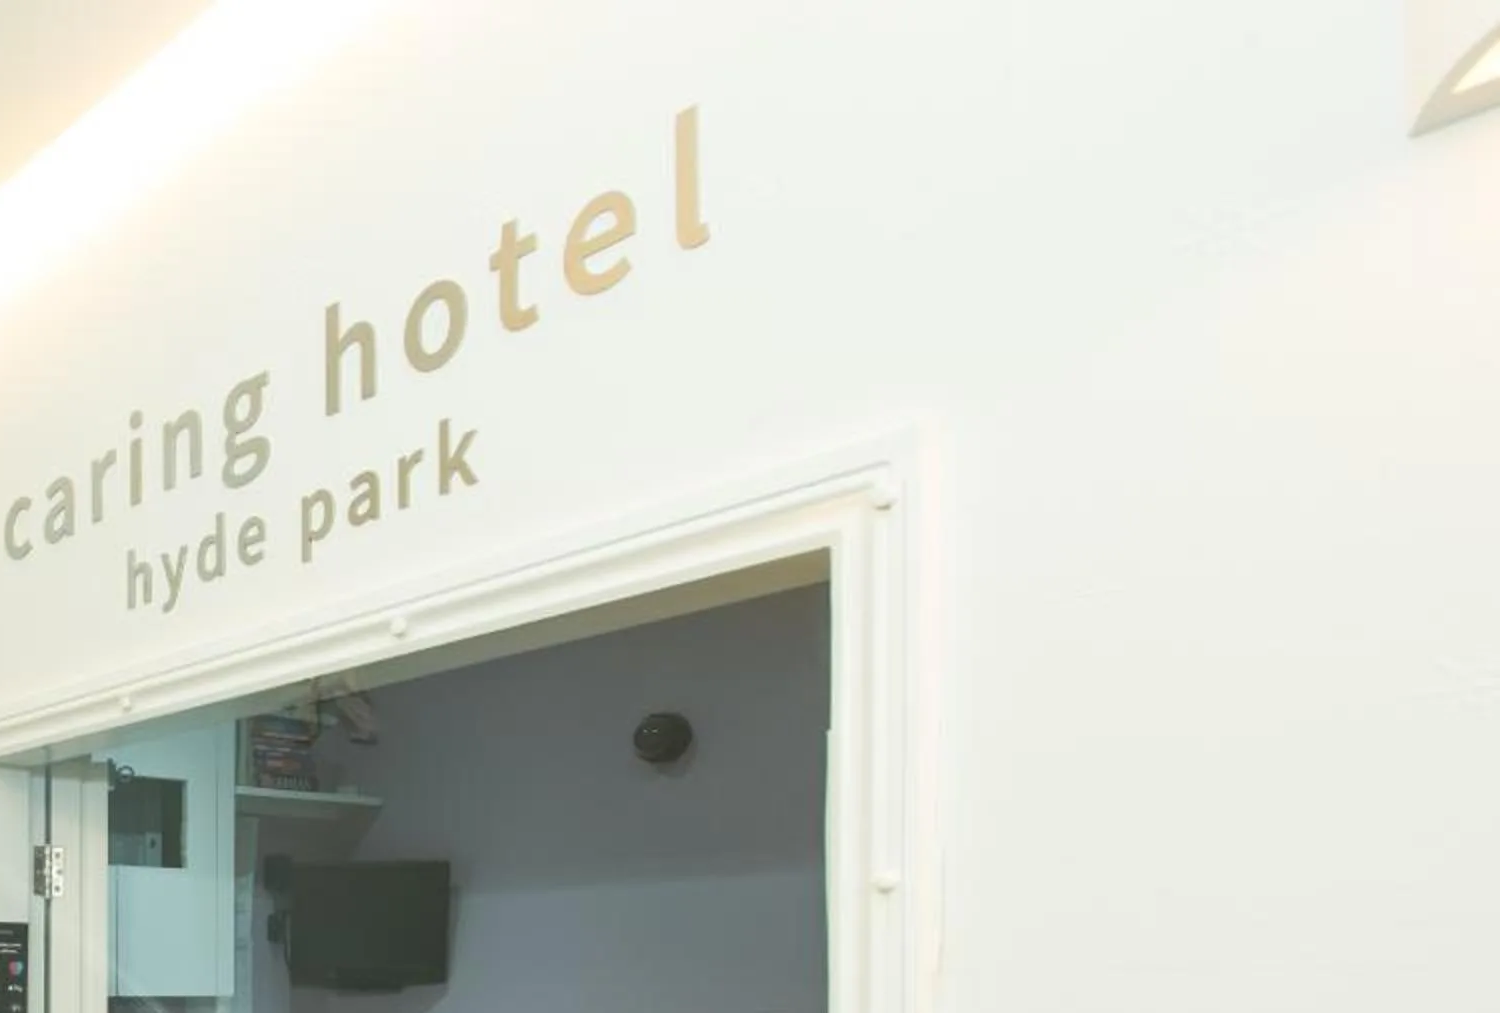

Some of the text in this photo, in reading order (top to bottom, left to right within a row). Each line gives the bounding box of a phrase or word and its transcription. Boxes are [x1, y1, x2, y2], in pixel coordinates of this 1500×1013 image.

[2, 103, 711, 563] caring hotel
[125, 416, 480, 615] hyde park
